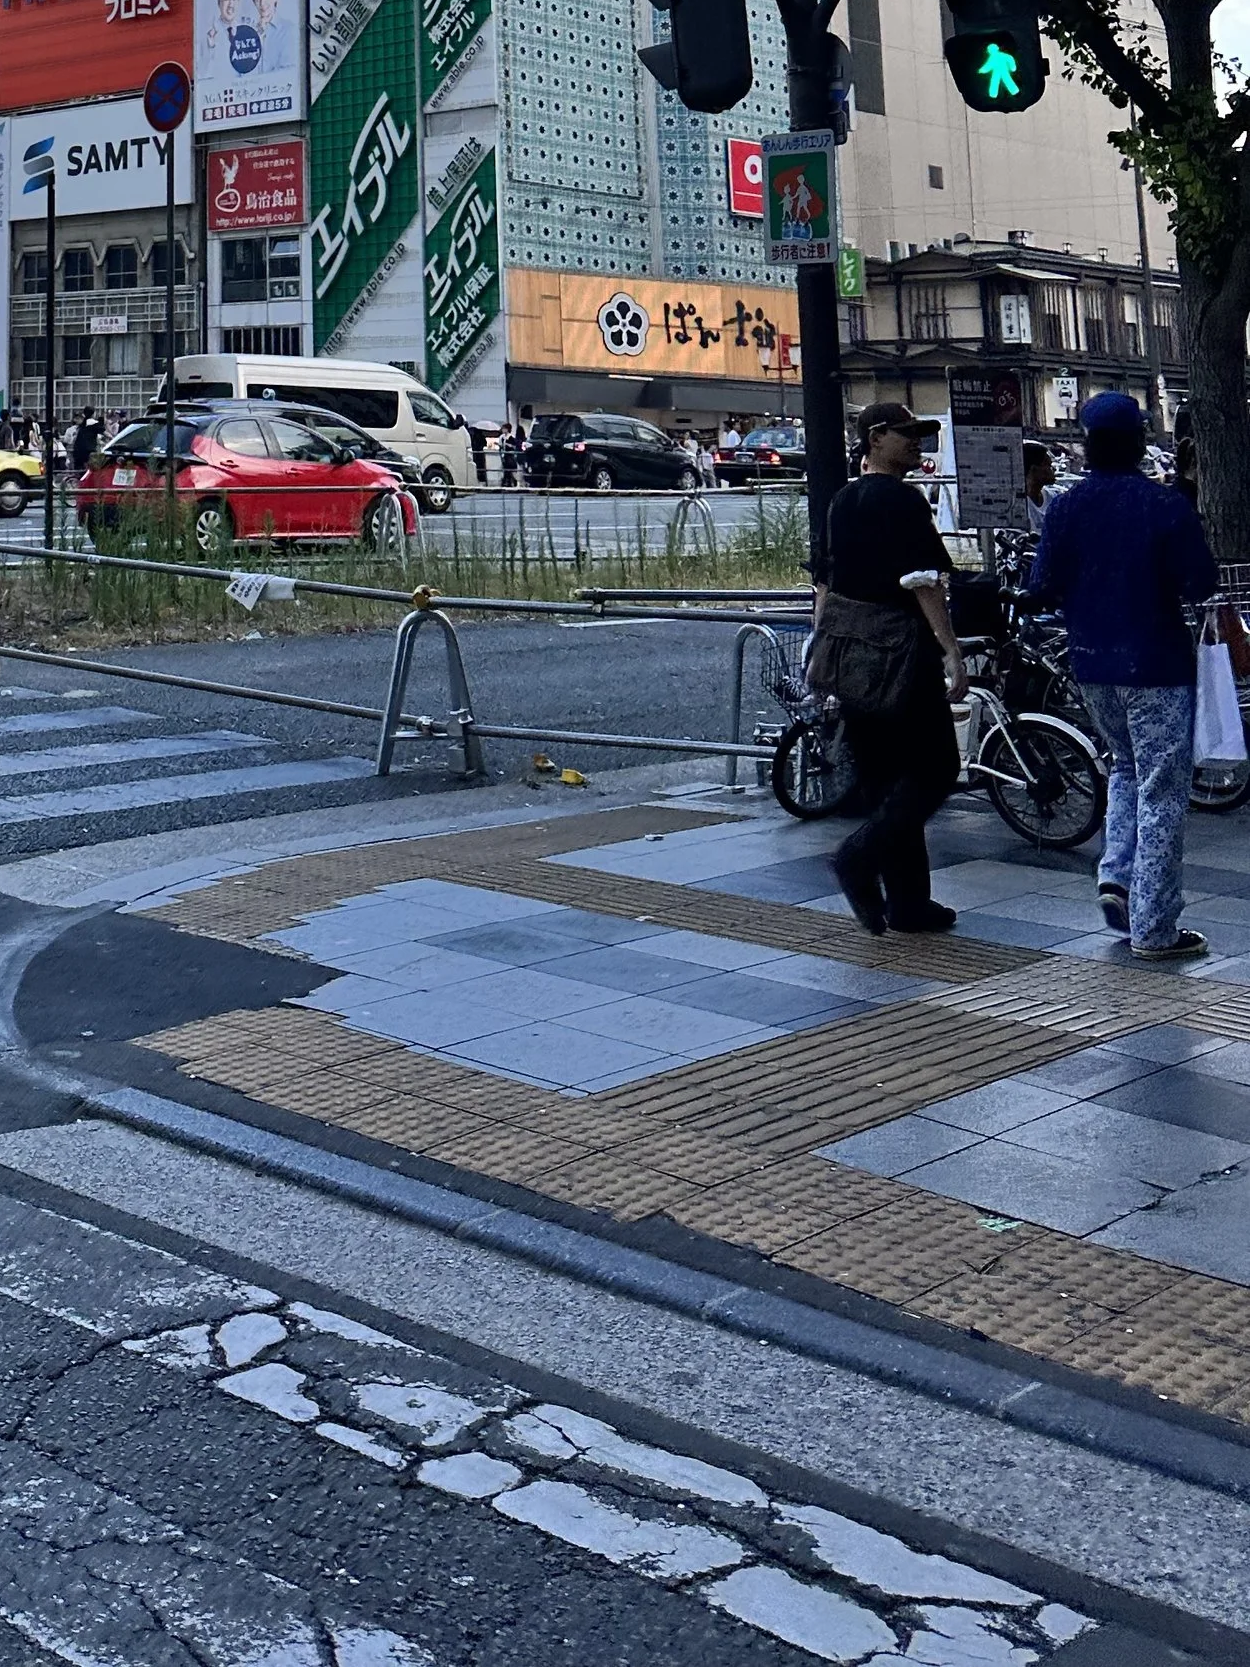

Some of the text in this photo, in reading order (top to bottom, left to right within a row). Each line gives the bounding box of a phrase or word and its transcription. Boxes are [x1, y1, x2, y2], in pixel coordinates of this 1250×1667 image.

[430, 35, 485, 109] www.able.co.jp
[431, 11, 476, 72] エイブル
[67, 135, 169, 176] SAMTY
[762, 135, 831, 152] あんしん歩行エリア
[308, 91, 411, 300] エイブル
[423, 181, 495, 316] エイブル
[771, 242, 830, 261] 歩行者に注意!
[843, 252, 855, 292] レイク
[427, 262, 496, 351] エイブル保証
[437, 306, 486, 368] 株式会社
[1060, 367, 1069, 376] 2
